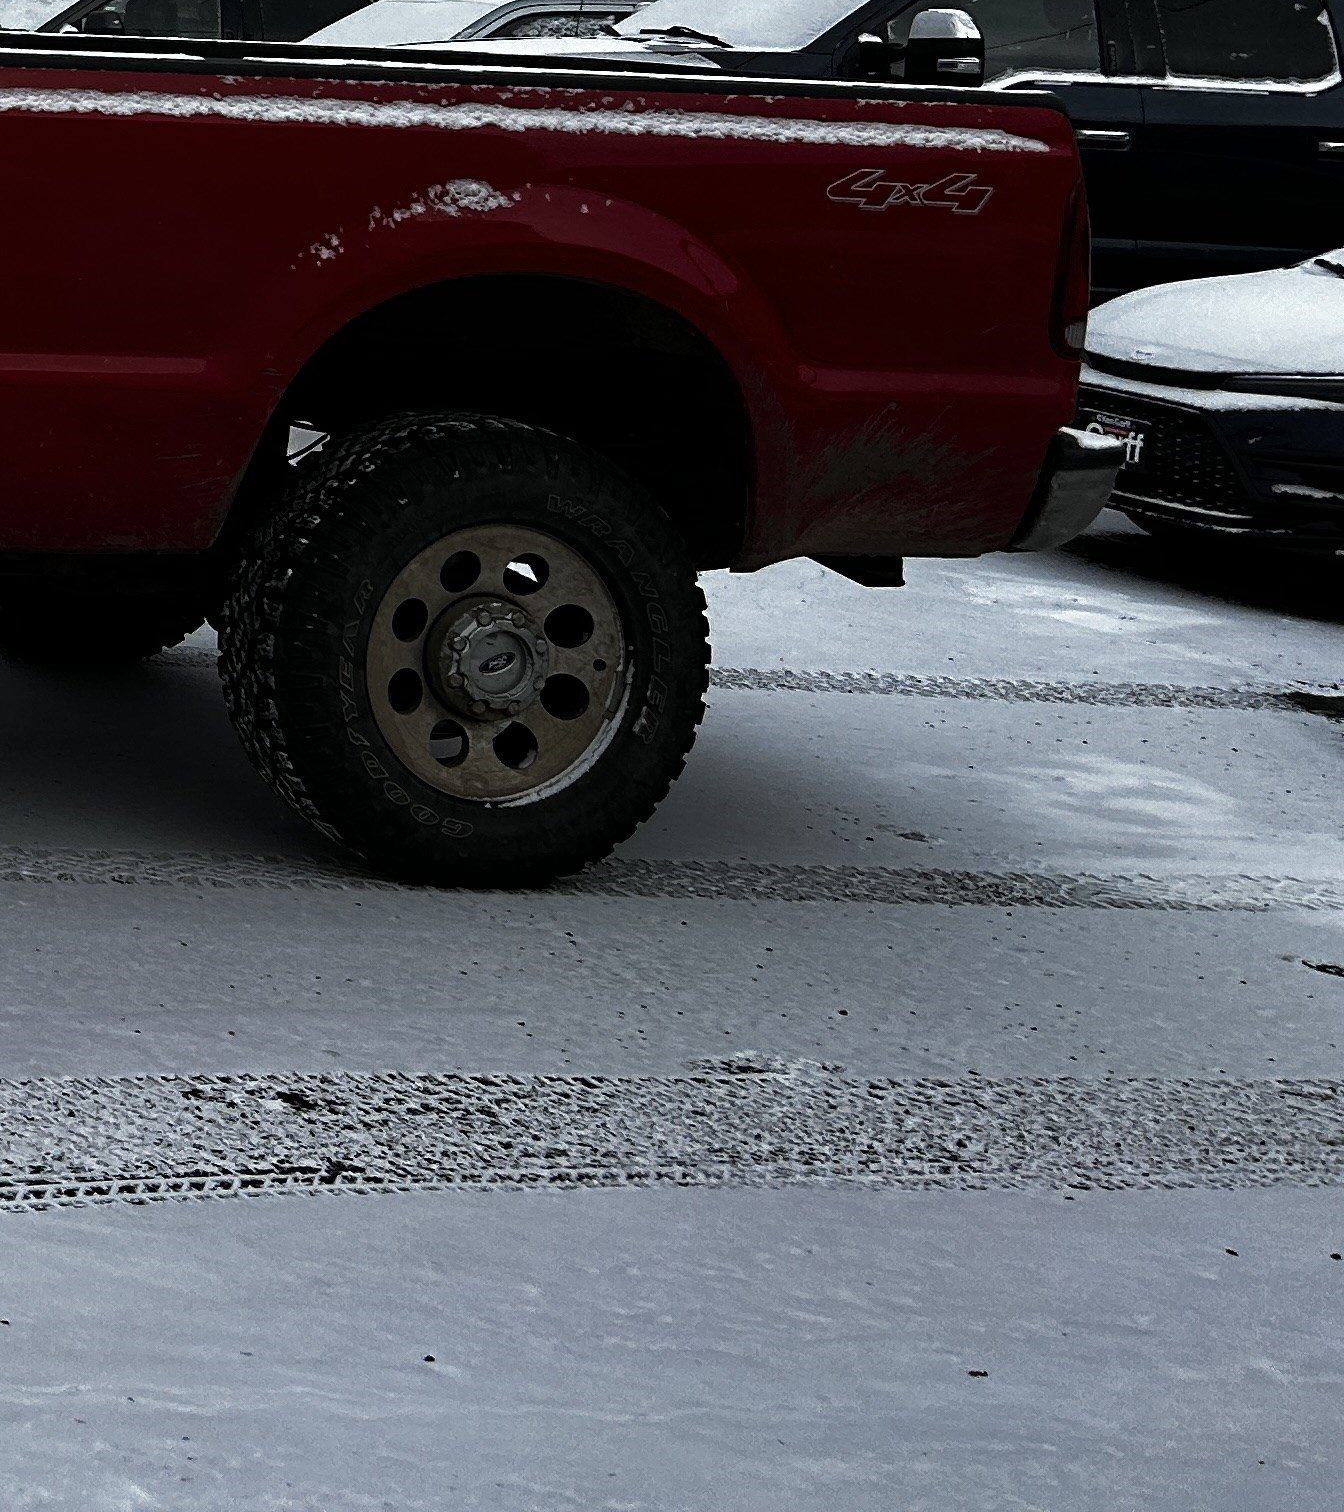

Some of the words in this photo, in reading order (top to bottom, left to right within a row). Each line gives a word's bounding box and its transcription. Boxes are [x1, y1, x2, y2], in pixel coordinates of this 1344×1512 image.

[827, 169, 994, 215] 4x4
[339, 579, 474, 838] GOODYEAR
[547, 494, 671, 744] WRANGLER
